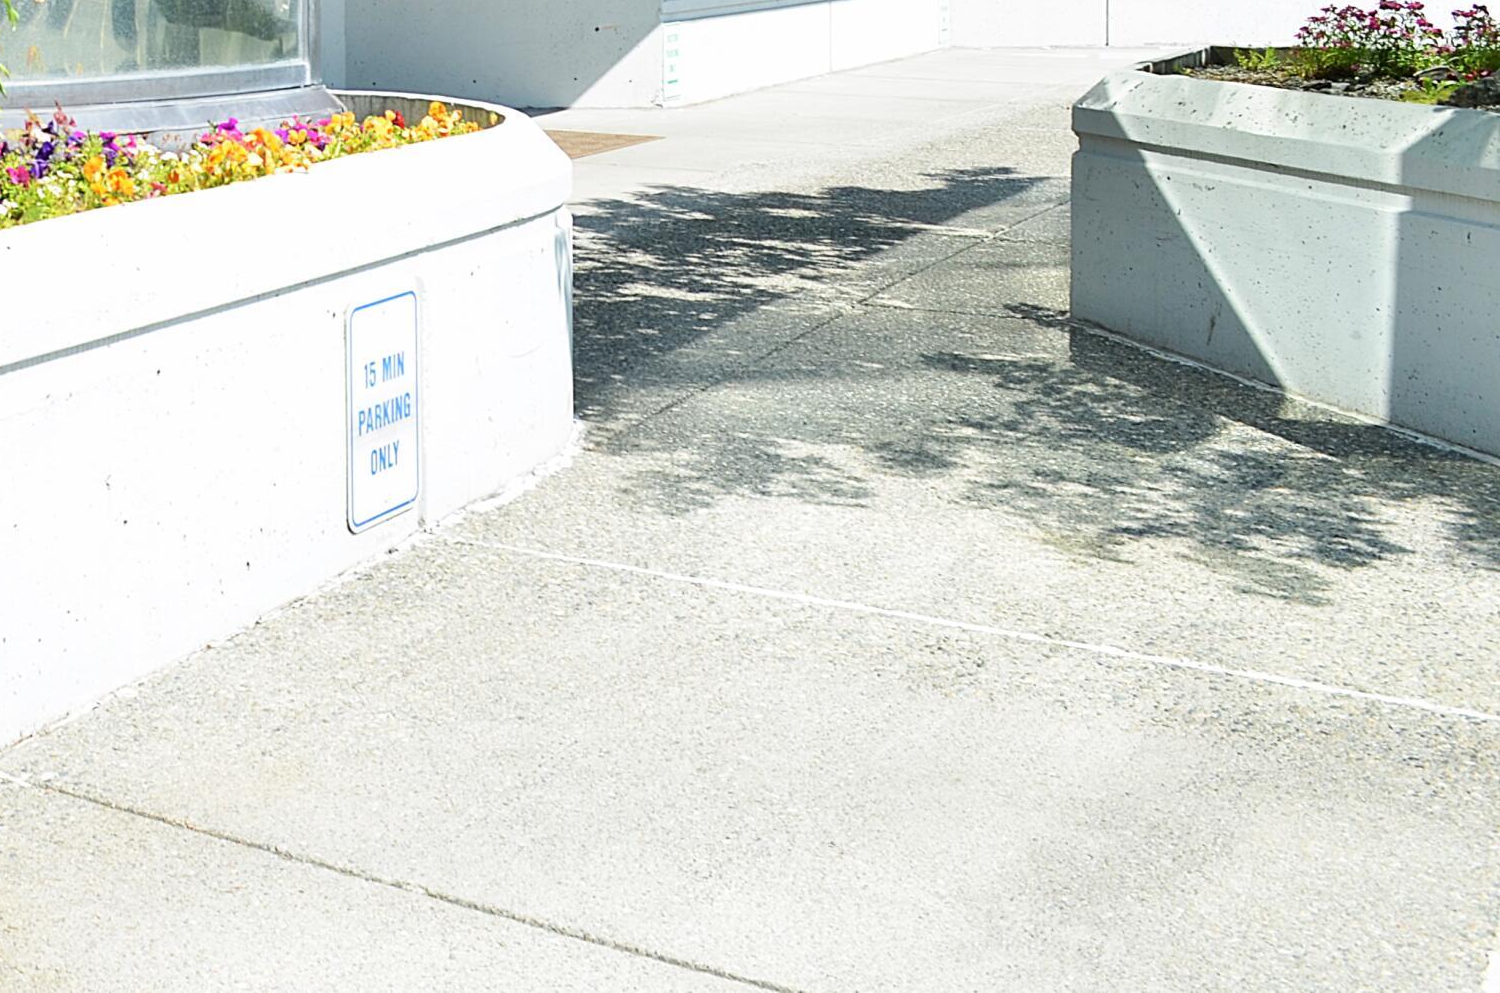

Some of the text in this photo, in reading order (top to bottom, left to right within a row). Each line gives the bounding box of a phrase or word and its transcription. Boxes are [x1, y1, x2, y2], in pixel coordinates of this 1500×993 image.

[364, 352, 405, 388] 15 MIN
[358, 392, 411, 436] PARKING
[370, 440, 400, 476] ONLY
